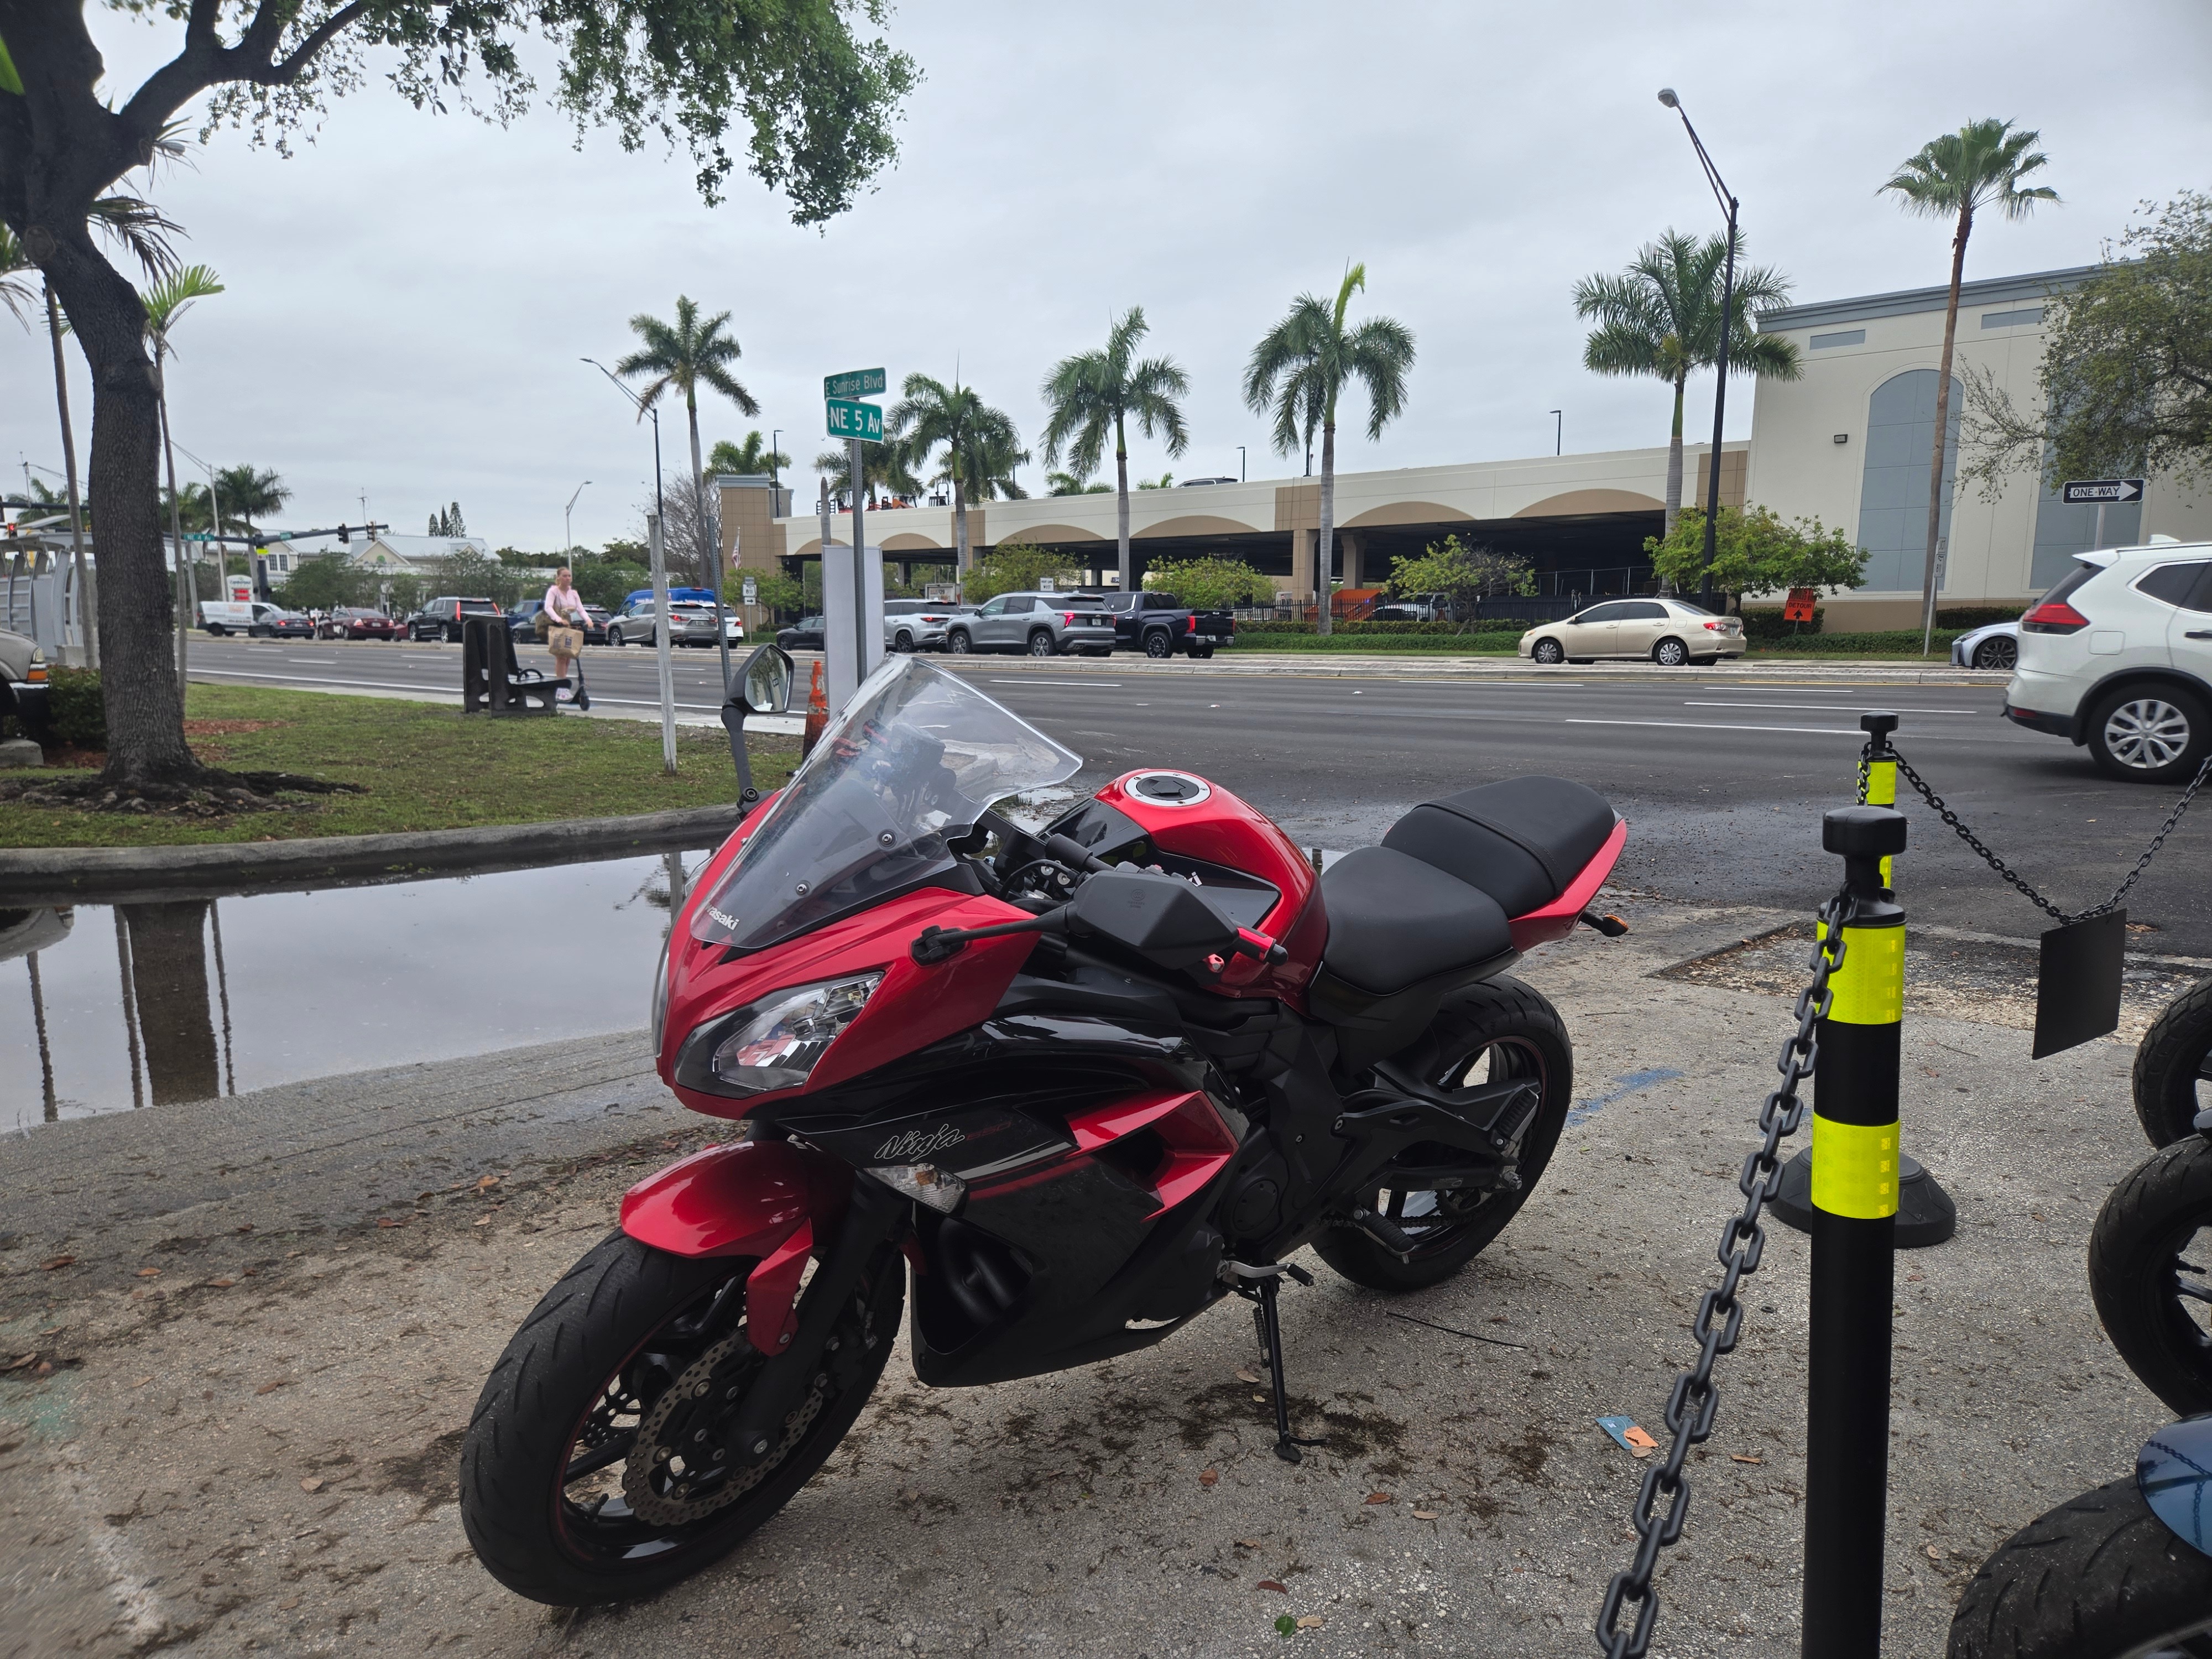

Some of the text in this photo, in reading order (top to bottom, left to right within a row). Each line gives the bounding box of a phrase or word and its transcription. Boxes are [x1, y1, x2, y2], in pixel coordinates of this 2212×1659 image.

[826, 374, 884, 396] E Sunrise Blvd
[830, 406, 880, 434] NE 5 Av
[2073, 487, 2120, 497] ONE WAY
[706, 903, 740, 931] asaki
[874, 1121, 1012, 1162] Ninja 650
